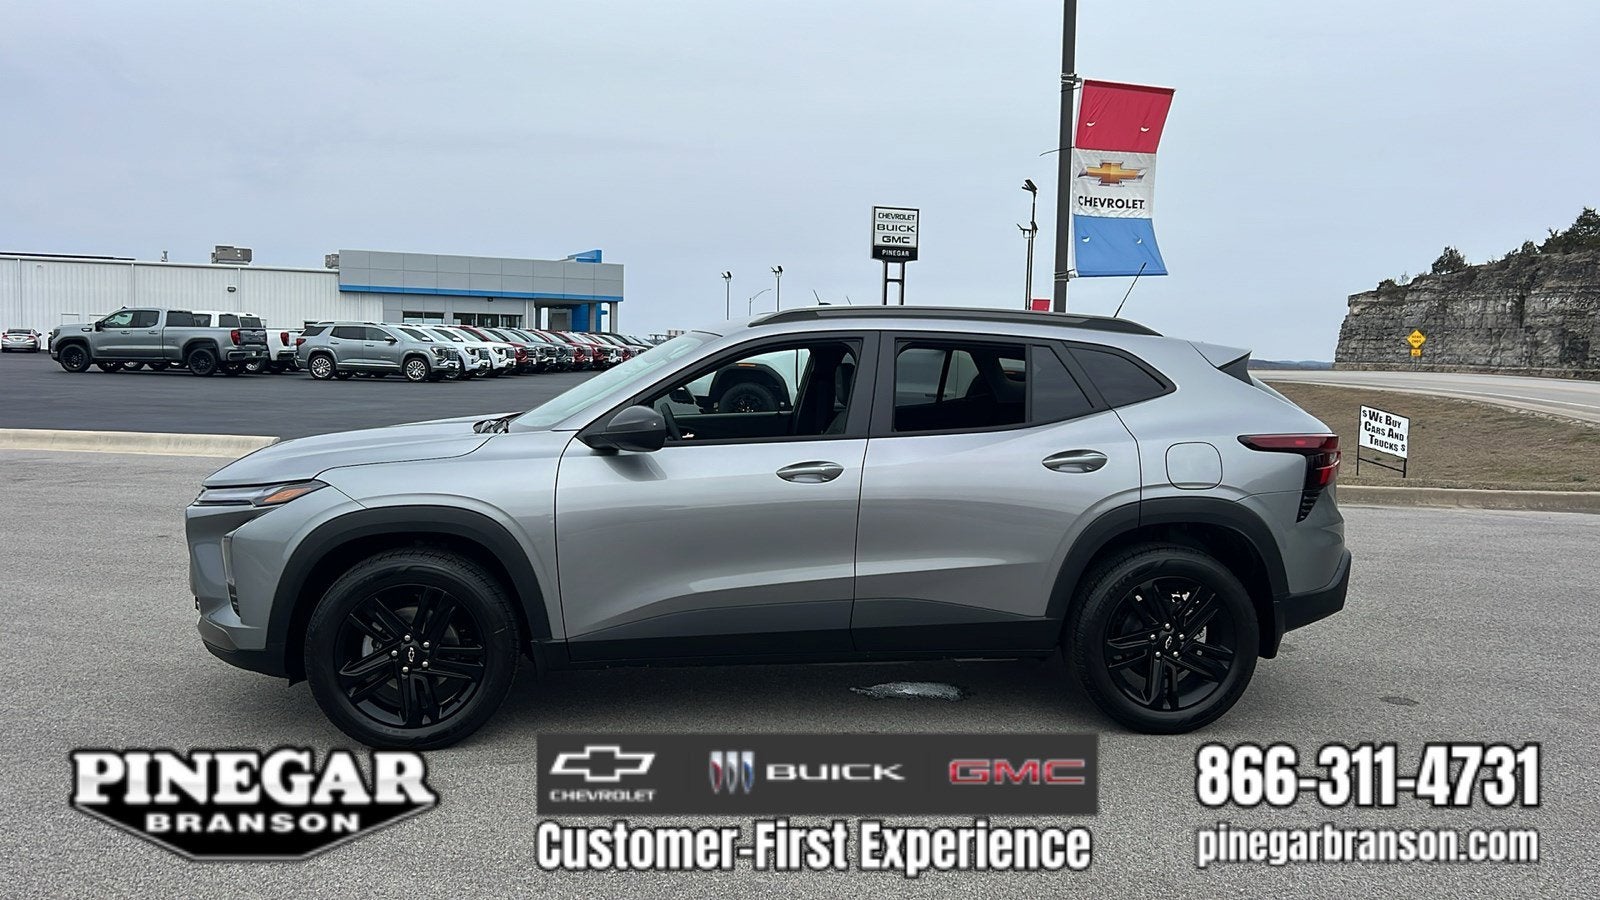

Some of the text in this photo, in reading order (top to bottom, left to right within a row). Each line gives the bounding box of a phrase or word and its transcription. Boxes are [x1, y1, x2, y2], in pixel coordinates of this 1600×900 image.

[1078, 195, 1145, 209] CHEVROLET
[878, 212, 915, 221] CHEVROLET
[877, 223, 915, 233] BUICK
[882, 235, 910, 244] GMC
[881, 249, 910, 257] PINEGAR
[1364, 421, 1386, 437] CARS
[1369, 433, 1399, 452] TRUCKS
